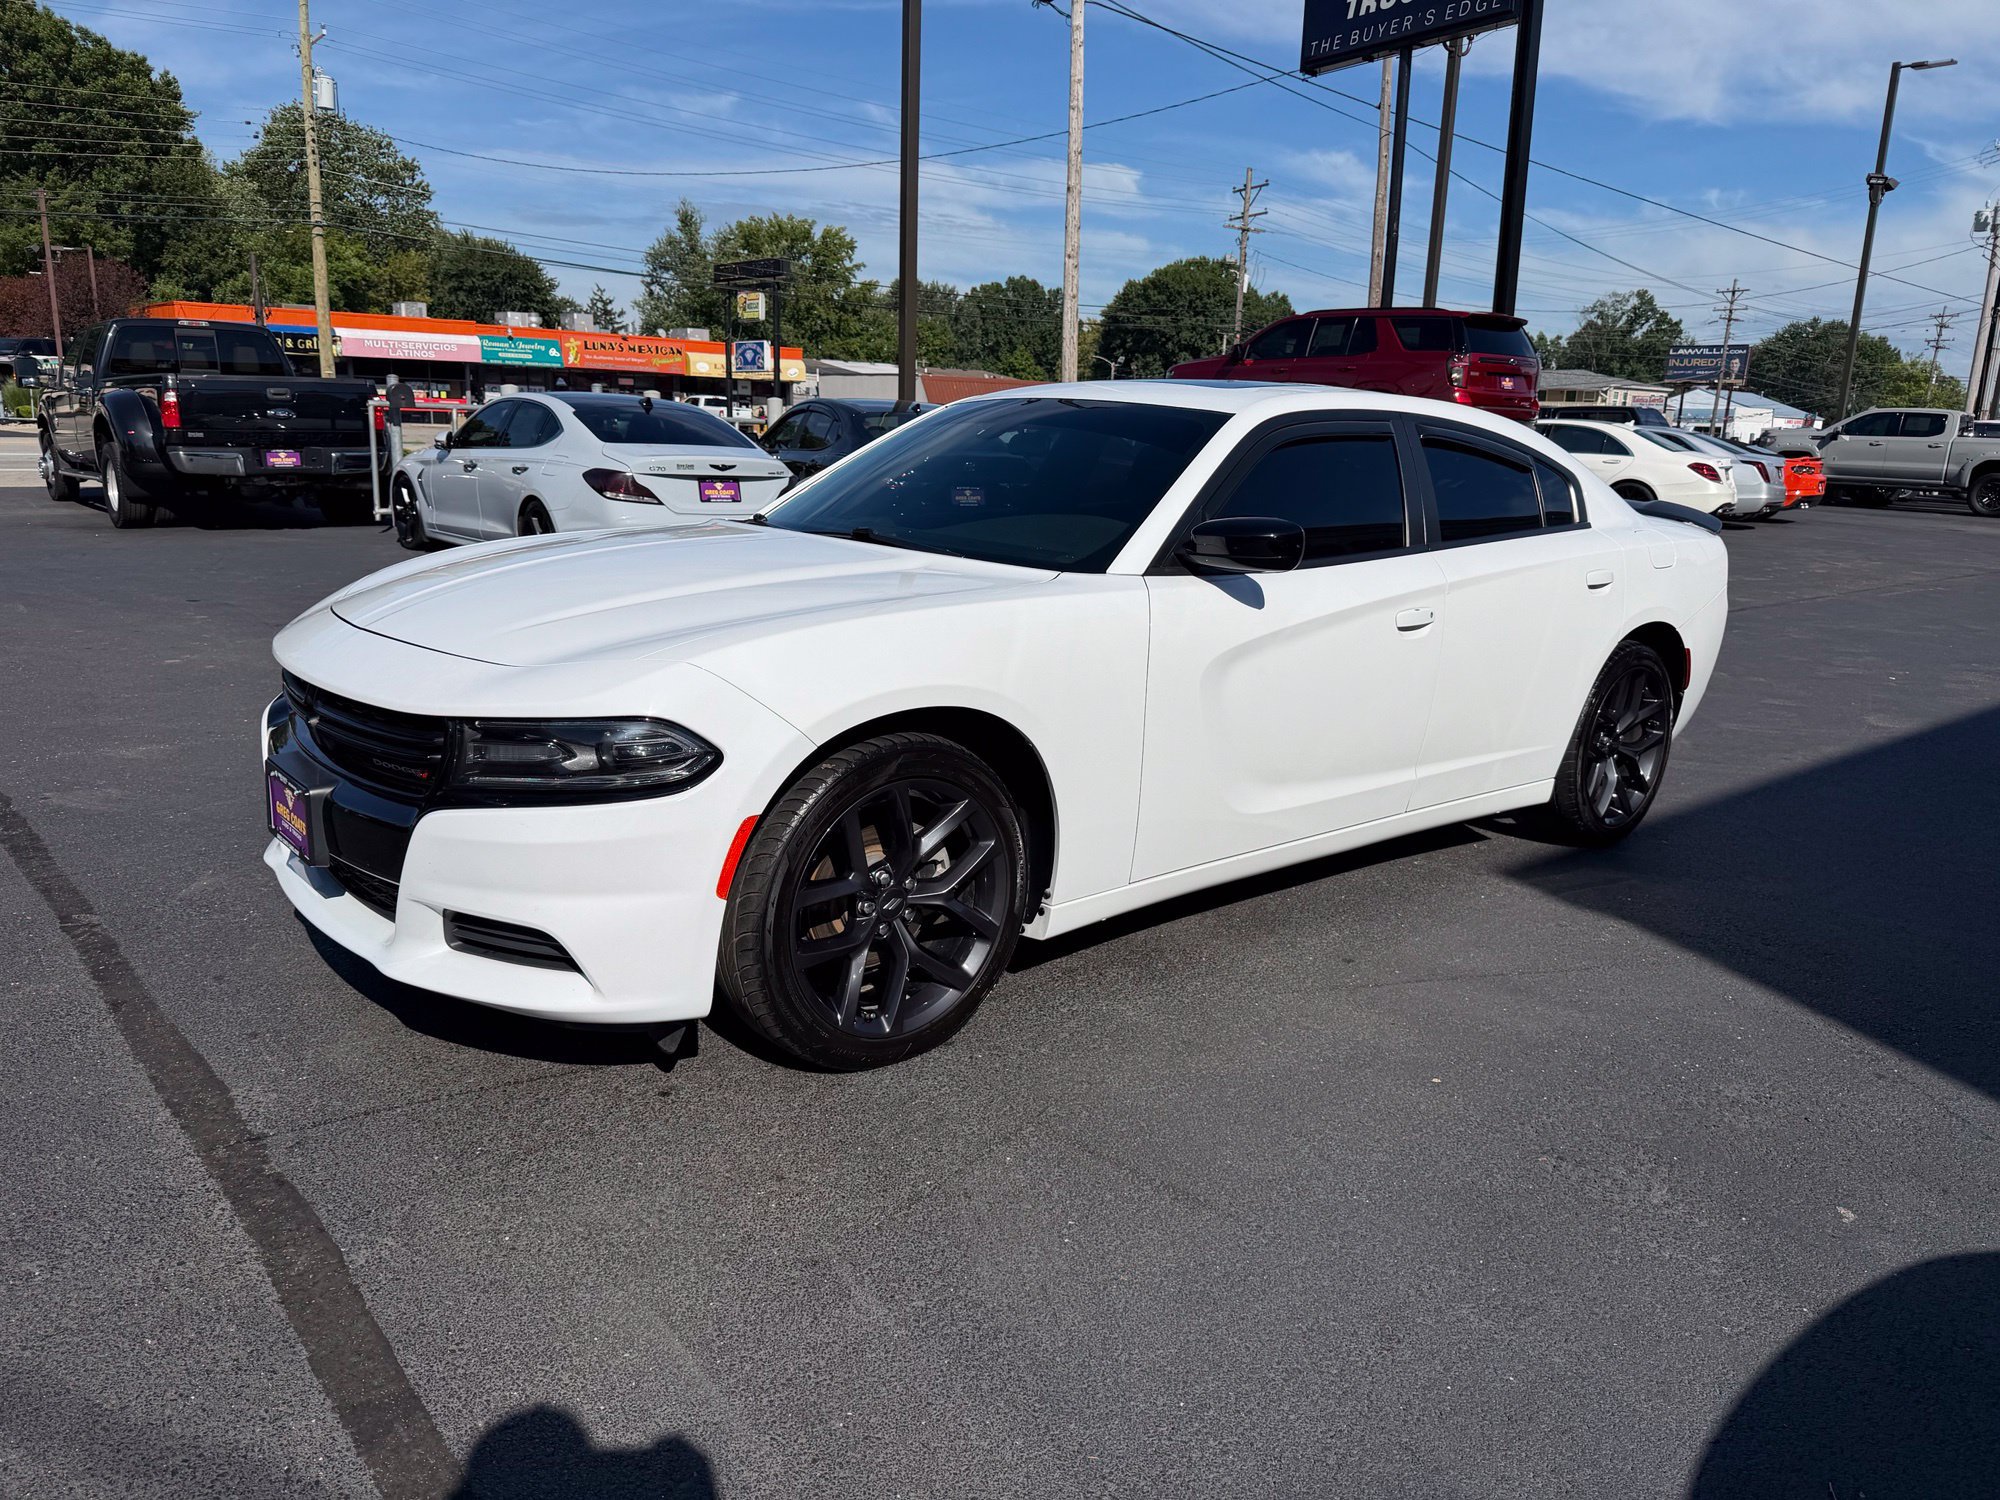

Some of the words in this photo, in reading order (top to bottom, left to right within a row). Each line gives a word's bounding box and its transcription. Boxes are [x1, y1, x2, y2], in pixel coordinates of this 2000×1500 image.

[1310, 34, 1343, 56] THE
[1349, 9, 1436, 46] BUYER'S
[285, 338, 294, 348] &
[297, 336, 320, 349] GRI
[364, 340, 458, 351] MULTI-SERVICIOS
[516, 341, 546, 351] Jewelry
[584, 340, 625, 352] LUNA'S
[628, 344, 683, 356] MEXICAN
[388, 348, 436, 358] LATINOS
[275, 800, 290, 821] GREG
[290, 812, 307, 836] COATS
